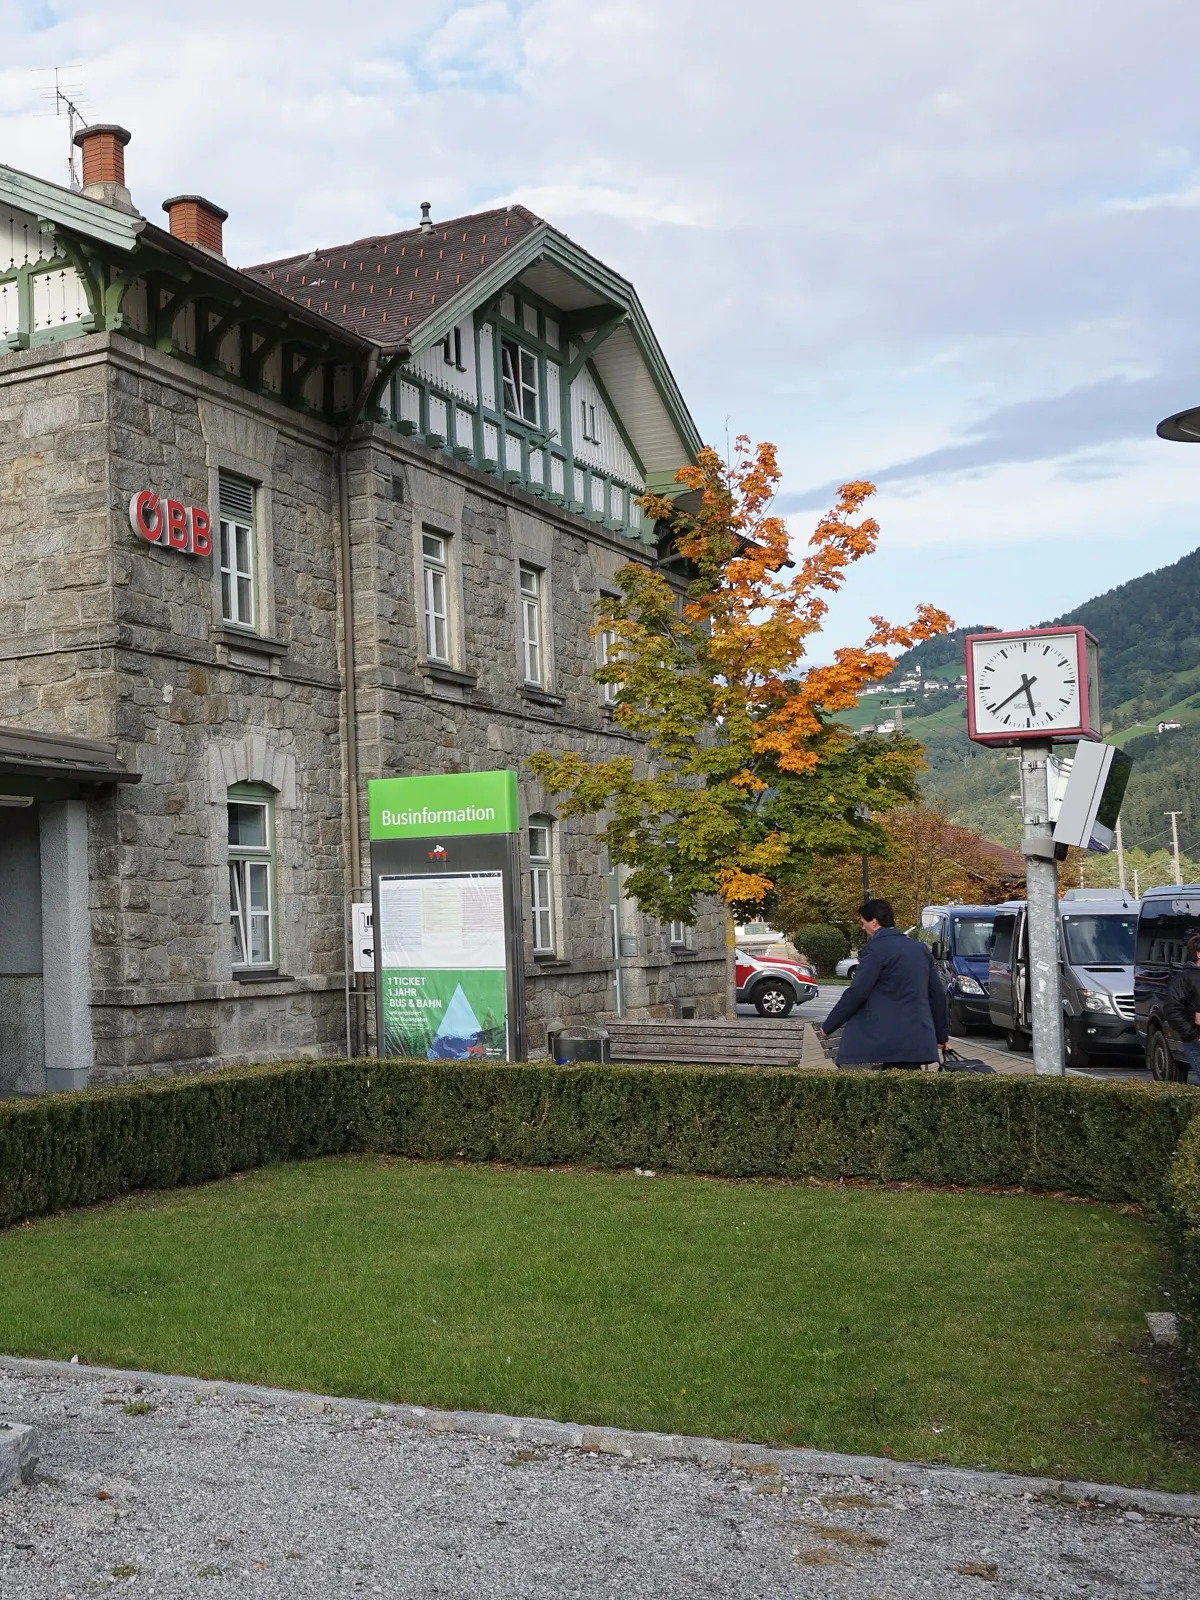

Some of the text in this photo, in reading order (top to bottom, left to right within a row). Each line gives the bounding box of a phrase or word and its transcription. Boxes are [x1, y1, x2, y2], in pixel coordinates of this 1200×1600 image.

[132, 490, 212, 556] ÖBB
[381, 805, 496, 827] Businformation
[388, 977, 427, 986] 1 TICKET
[393, 988, 418, 997] JAHR
[390, 999, 443, 1008] BUS & BAHN
